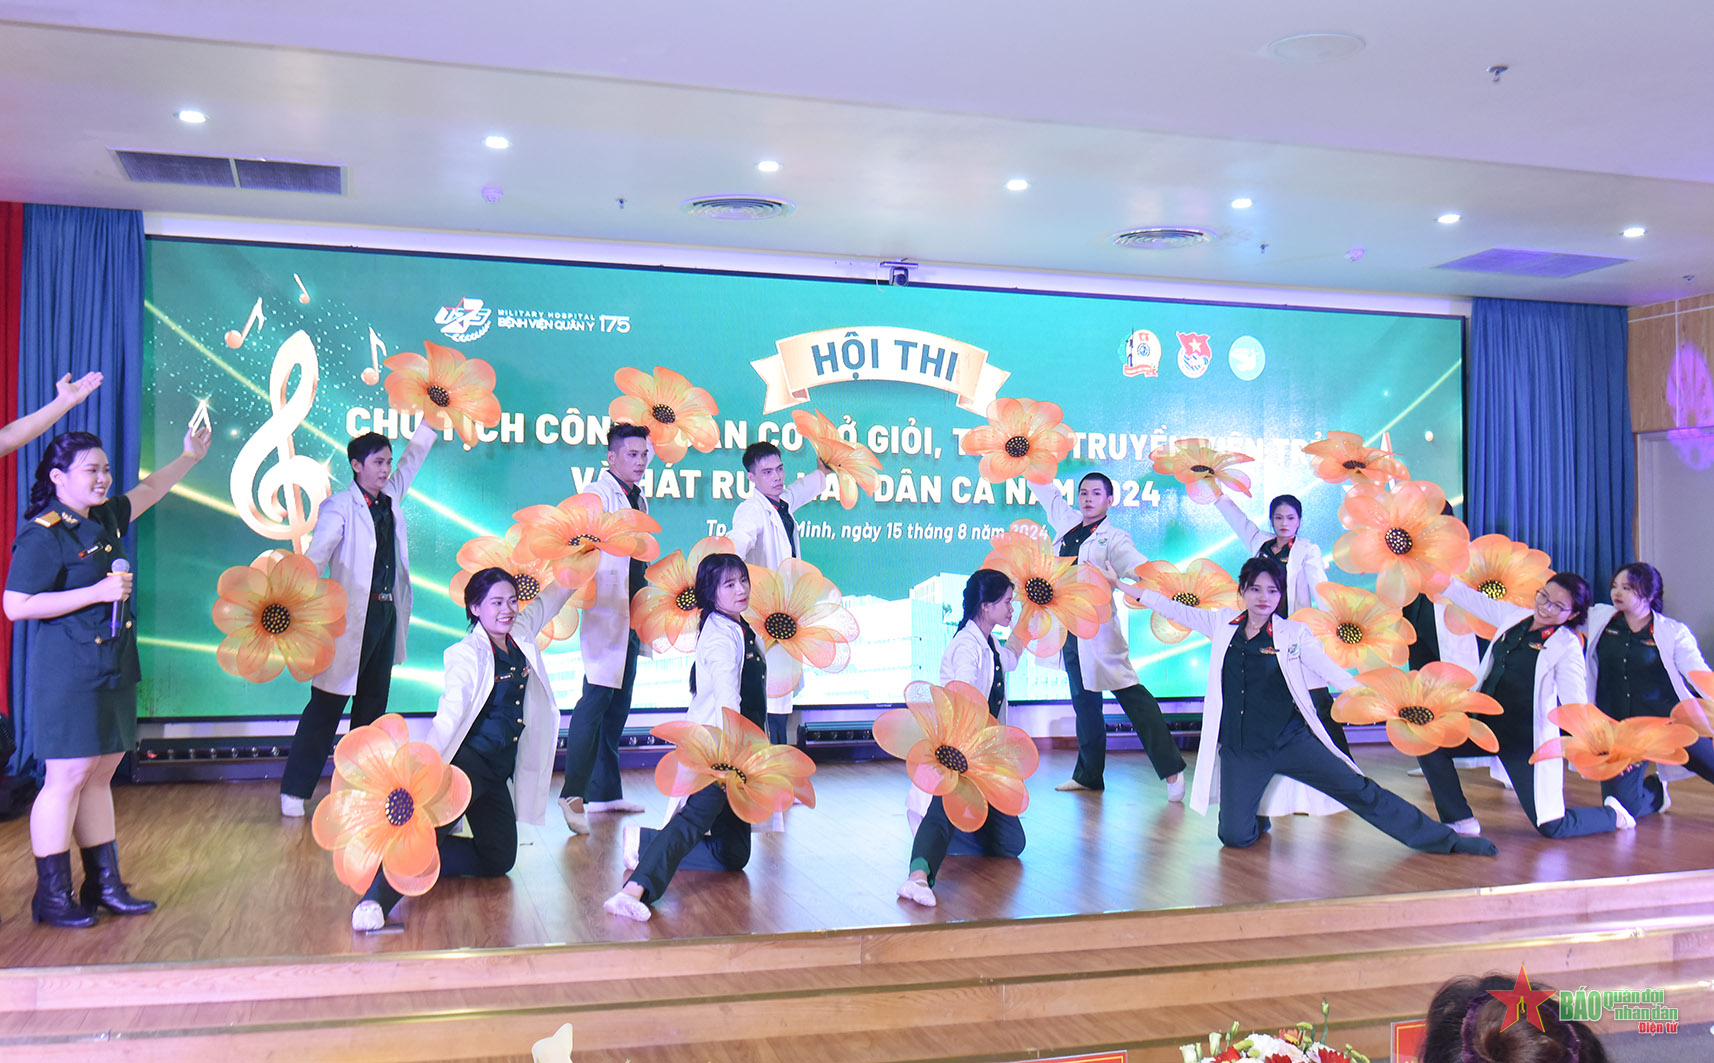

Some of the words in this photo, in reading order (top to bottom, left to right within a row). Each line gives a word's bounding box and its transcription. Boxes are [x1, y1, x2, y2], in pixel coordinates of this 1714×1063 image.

[498, 309, 544, 319] MILITARY
[548, 311, 596, 321] HOSPITAL
[584, 321, 596, 332] Y
[599, 314, 632, 334] 175
[811, 331, 879, 381] HỘI
[894, 339, 959, 382] THI
[535, 408, 634, 446] CÔN
[867, 416, 942, 459] GIỎI,
[873, 468, 942, 504] DÂN
[951, 477, 995, 505] CA
[841, 522, 882, 543] ngày
[886, 522, 903, 540] 15
[907, 523, 954, 543] tháng
[957, 523, 967, 540] 8
[971, 524, 1005, 541] năm
